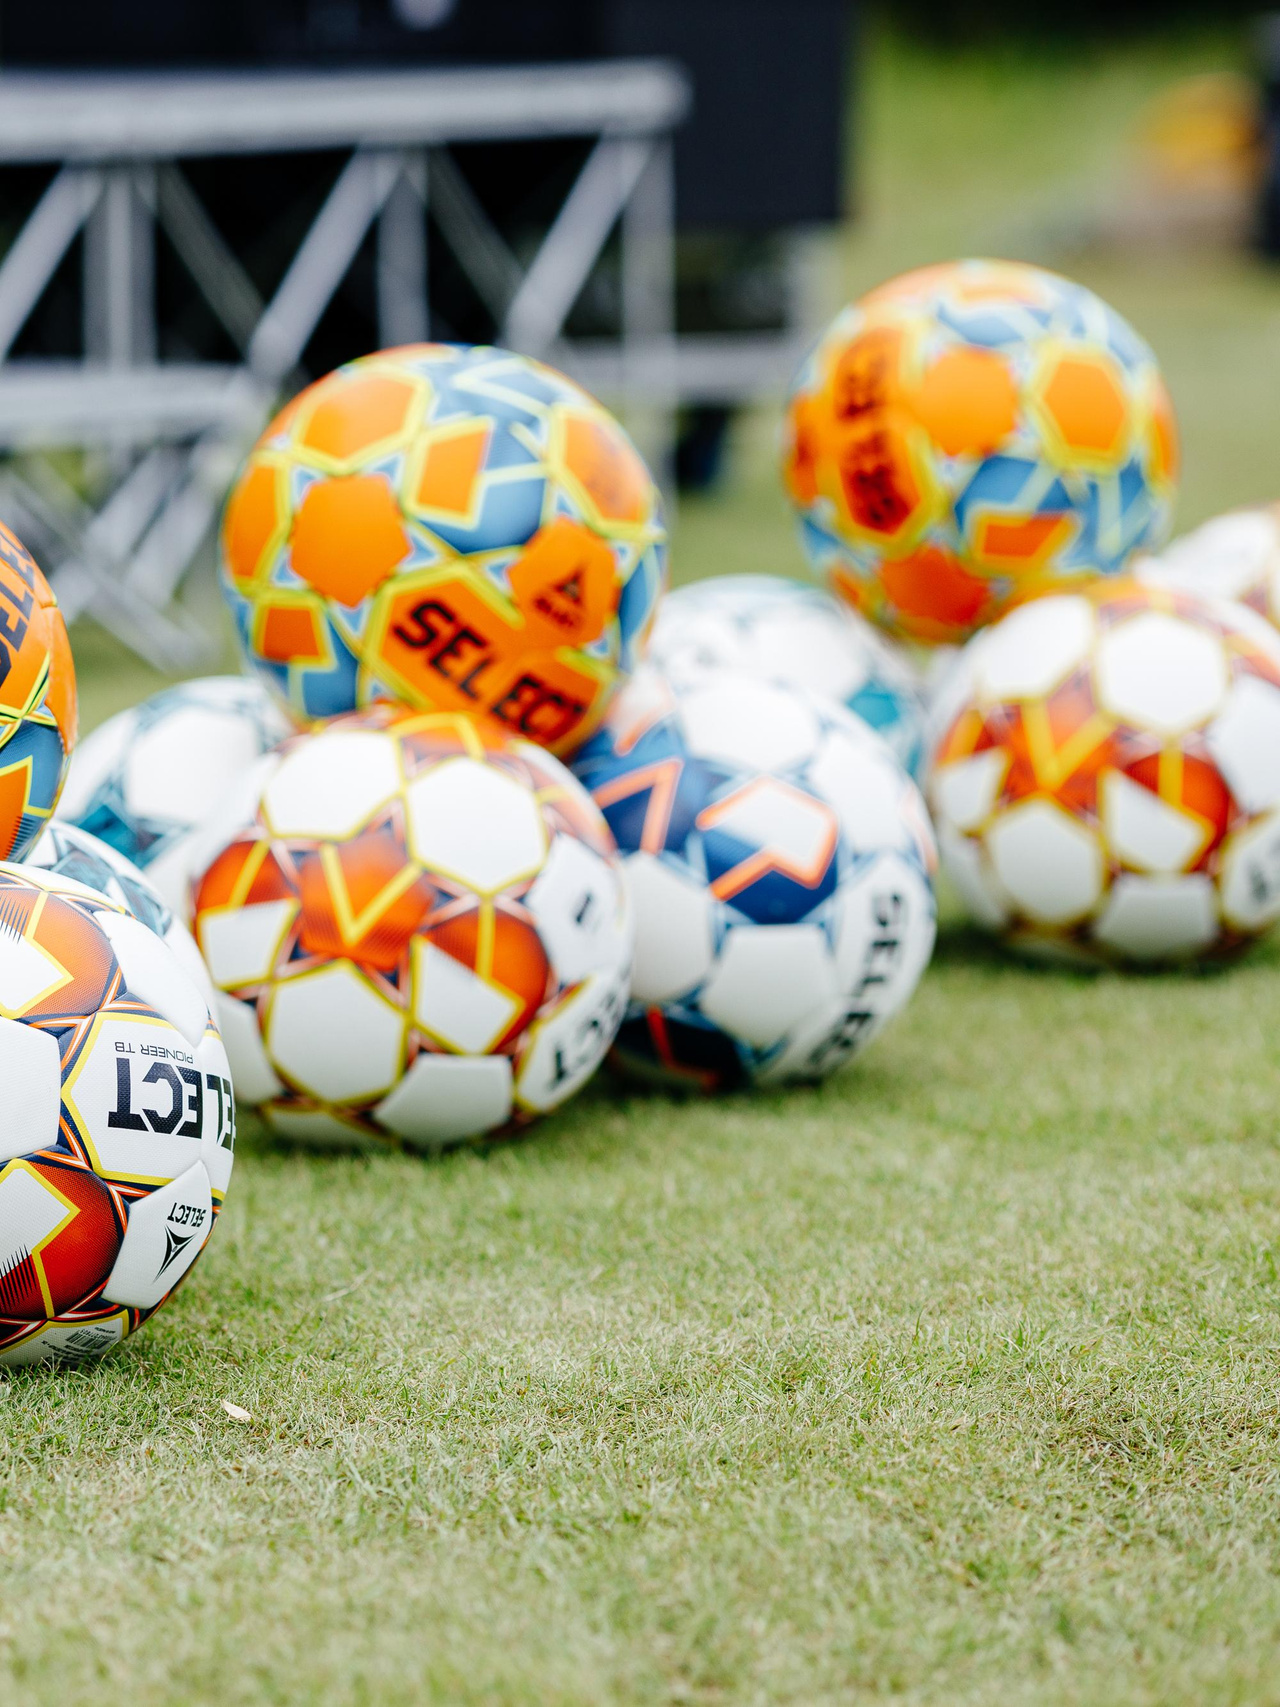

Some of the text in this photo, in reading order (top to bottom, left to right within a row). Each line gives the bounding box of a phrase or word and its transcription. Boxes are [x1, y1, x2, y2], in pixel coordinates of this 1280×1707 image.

[114, 1041, 194, 1064] PIONEER TB
[107, 1057, 237, 1154] ELECT
[166, 1201, 207, 1228] SELECT
